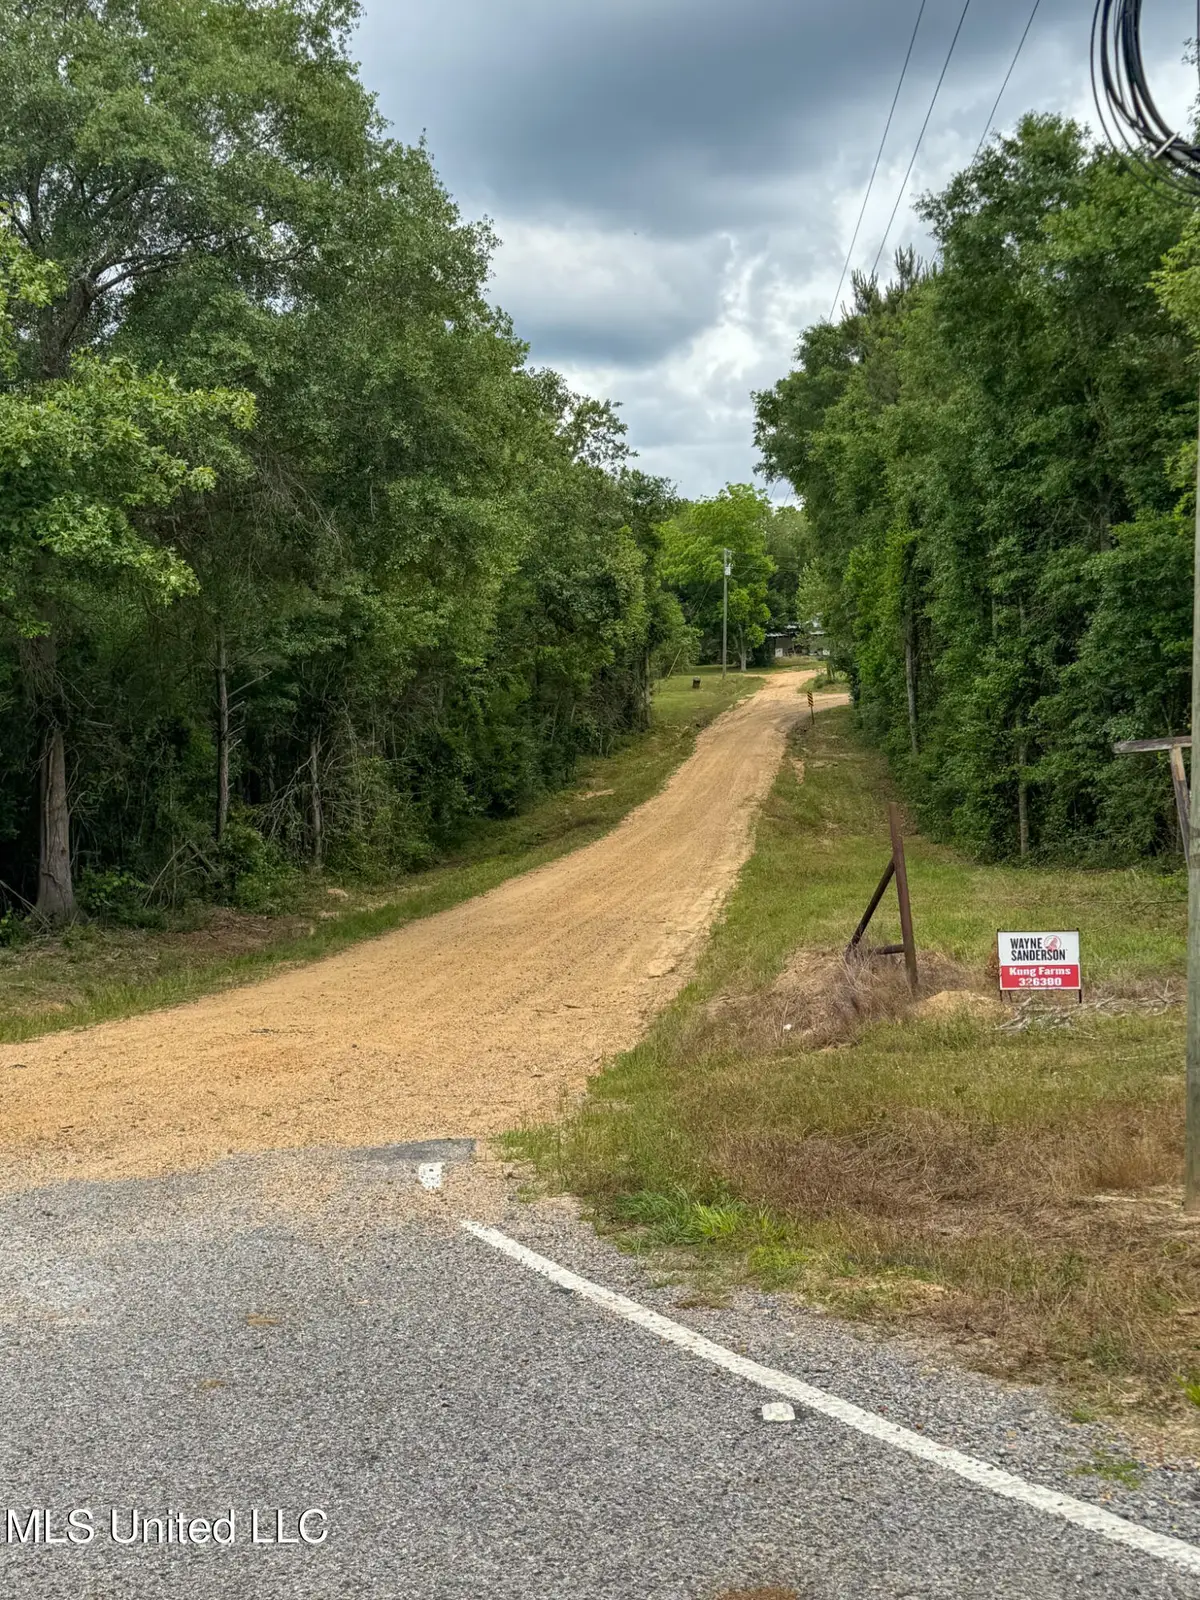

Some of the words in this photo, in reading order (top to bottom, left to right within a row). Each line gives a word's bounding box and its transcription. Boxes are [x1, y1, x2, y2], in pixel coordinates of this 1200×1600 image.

[1010, 938, 1042, 949] WAYNE
[1011, 949, 1066, 961] SANDERSON
[1038, 966, 1071, 975] Farms
